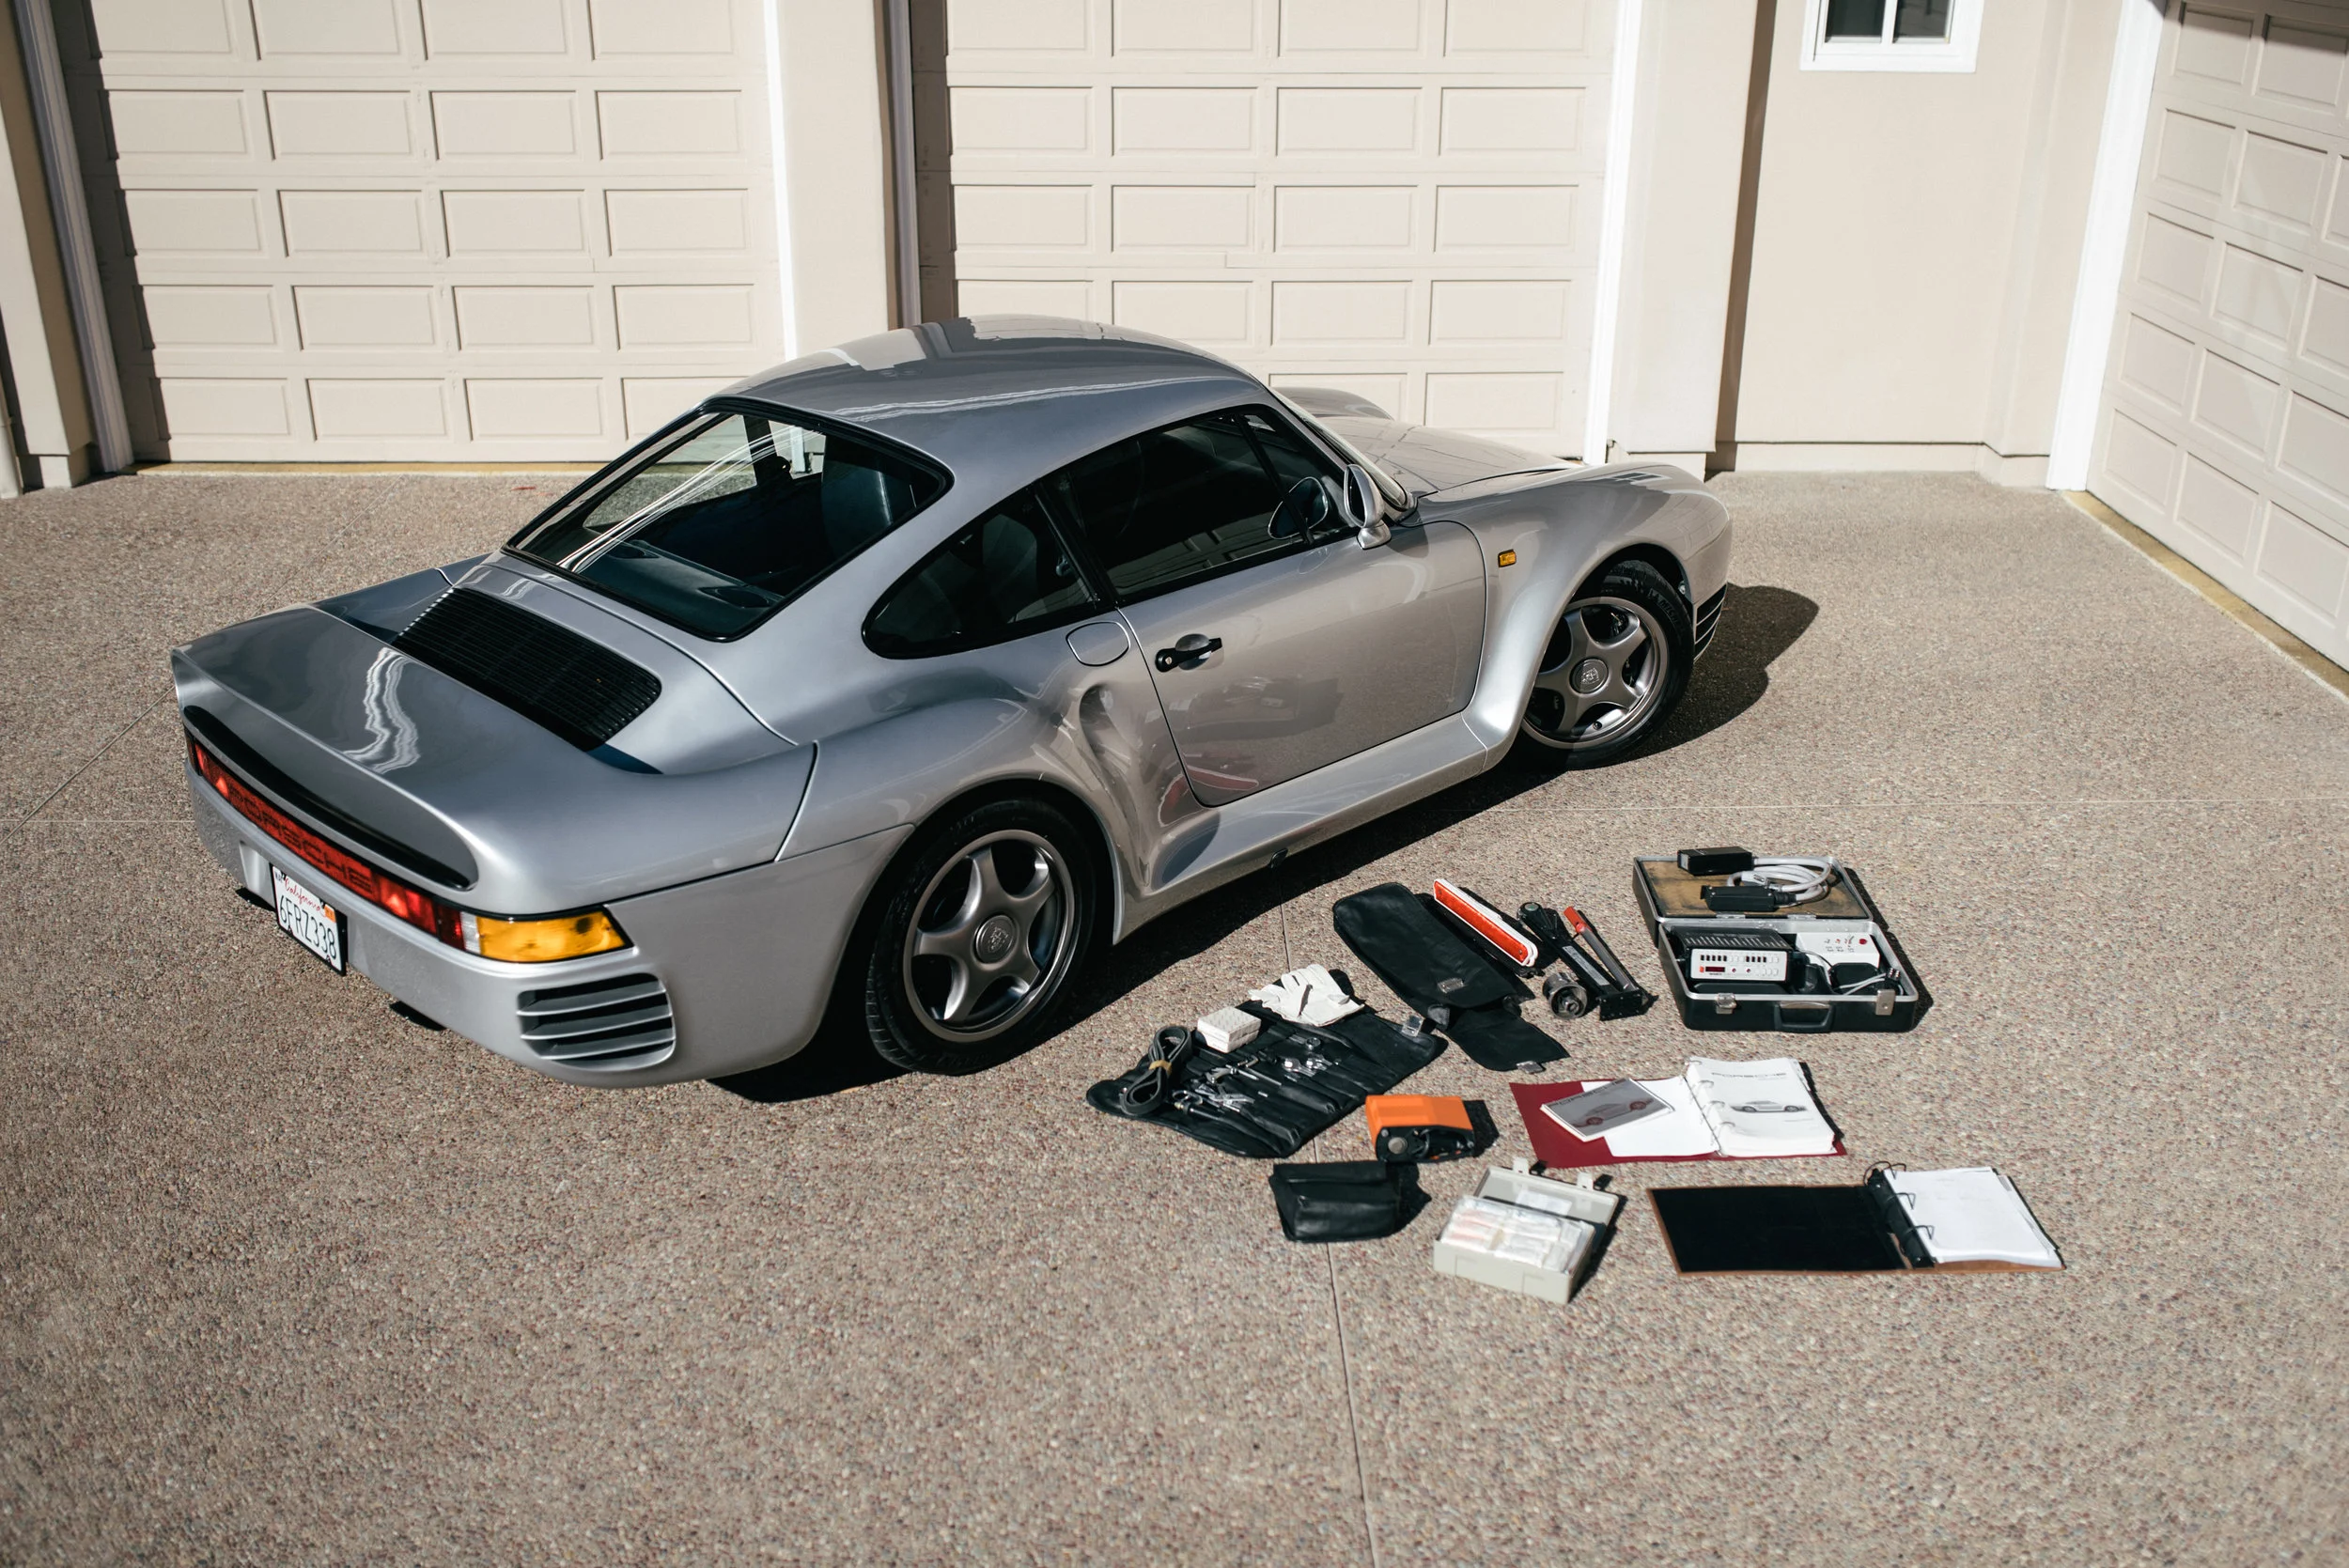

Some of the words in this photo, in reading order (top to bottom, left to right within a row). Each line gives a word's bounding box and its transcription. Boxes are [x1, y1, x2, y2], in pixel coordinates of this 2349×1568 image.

[227, 783, 374, 894] PORSCHE
[279, 894, 337, 960] 6FRZ338
[284, 877, 321, 911] California
